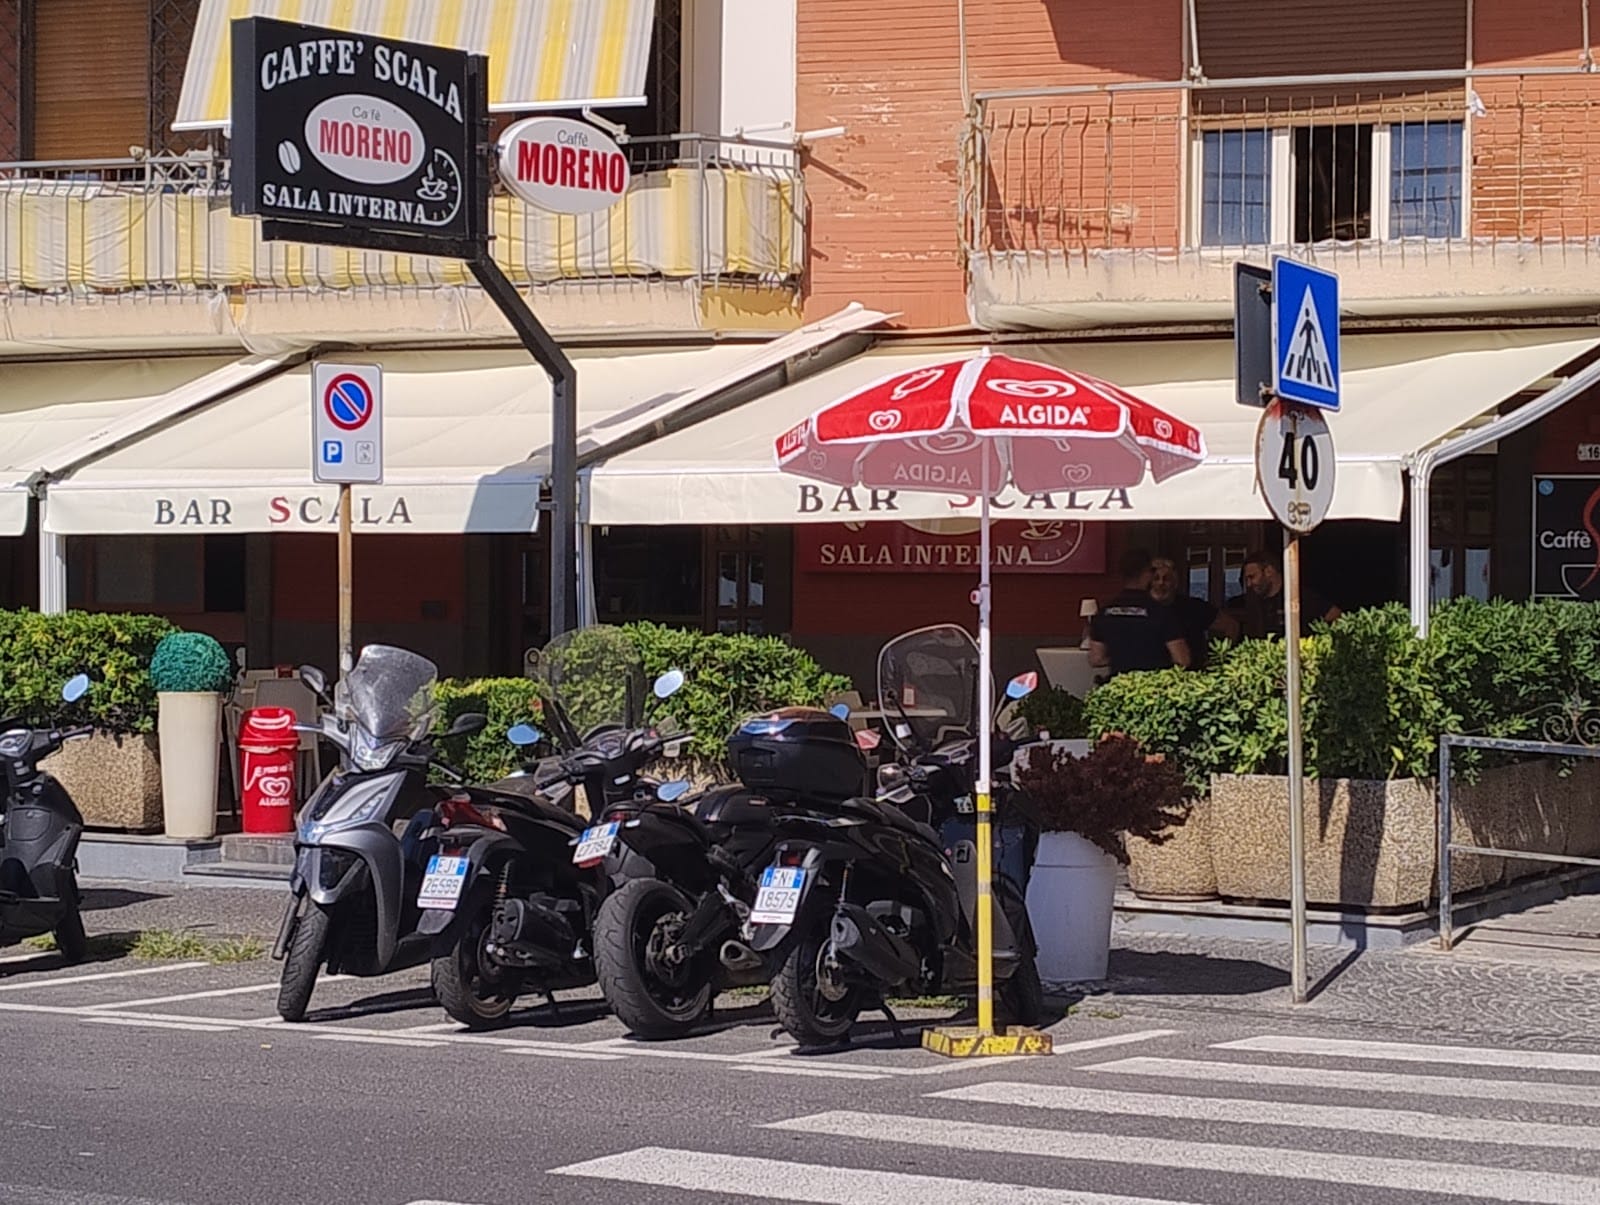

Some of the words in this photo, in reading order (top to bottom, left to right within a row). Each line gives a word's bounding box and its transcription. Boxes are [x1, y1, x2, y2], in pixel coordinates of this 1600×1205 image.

[374, 45, 463, 124] SCALA
[319, 119, 412, 165] MORENO
[557, 130, 588, 147] Caffè
[518, 139, 625, 194] MORENO
[263, 183, 322, 212] SALA
[328, 192, 427, 225] INTERNA
[326, 443, 340, 461] P
[1278, 432, 1318, 490] 40
[154, 499, 232, 525] BAR
[797, 484, 899, 513] BAR
[1540, 530, 1592, 549] Caffè
[820, 544, 893, 565] SALA
